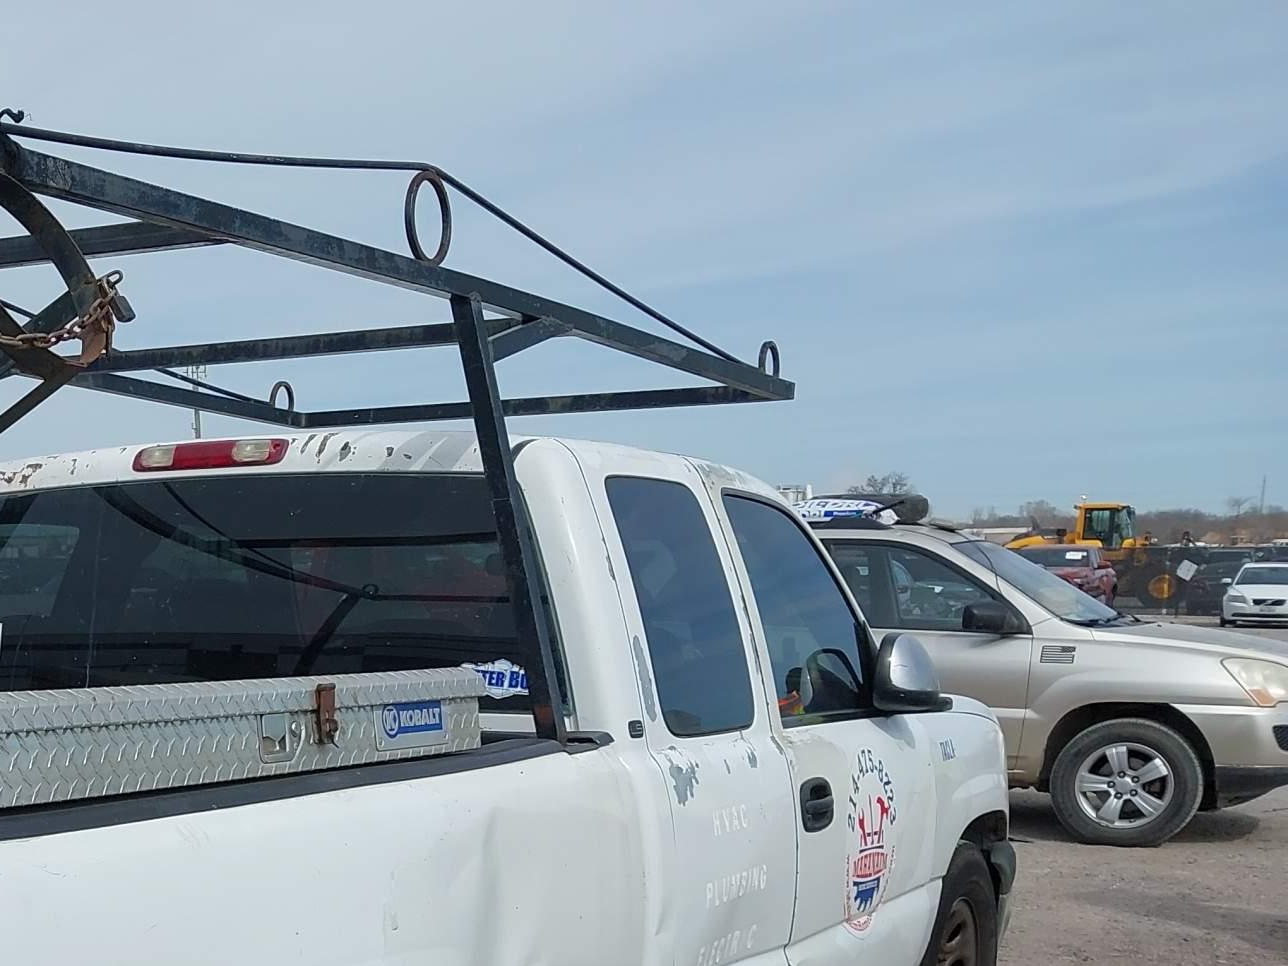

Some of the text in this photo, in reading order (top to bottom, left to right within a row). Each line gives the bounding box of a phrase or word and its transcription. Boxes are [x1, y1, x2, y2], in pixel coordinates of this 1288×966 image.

[399, 707, 441, 728] KOBALT
[847, 749, 897, 833] 214-475-8223
[713, 804, 748, 837] HVAC
[706, 864, 768, 909] PLUMBING
